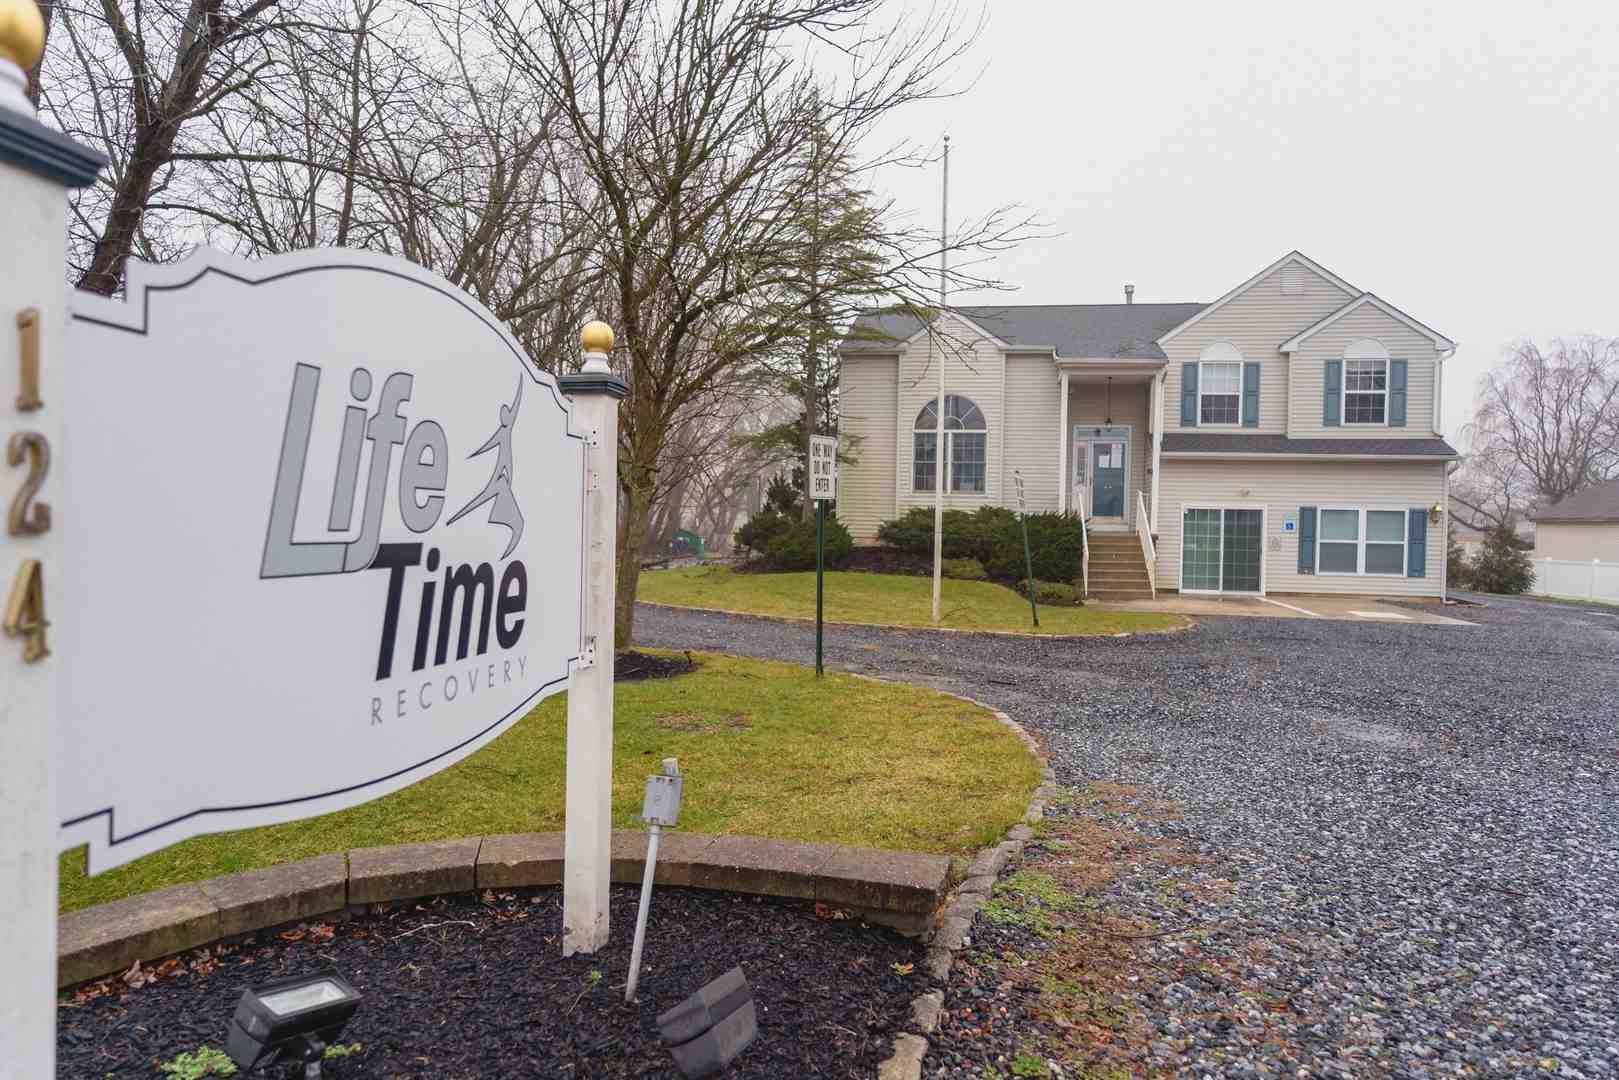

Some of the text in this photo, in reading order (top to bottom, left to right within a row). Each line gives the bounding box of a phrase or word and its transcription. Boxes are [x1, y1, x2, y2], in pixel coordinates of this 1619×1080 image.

[260, 363, 449, 578] Life
[812, 442, 833, 458] ONE WAY
[813, 460, 831, 475] DO NOT
[3, 307, 51, 665] 124
[815, 478, 830, 492] ENTER
[367, 542, 528, 681] Time
[371, 656, 528, 725] RECOVERY
